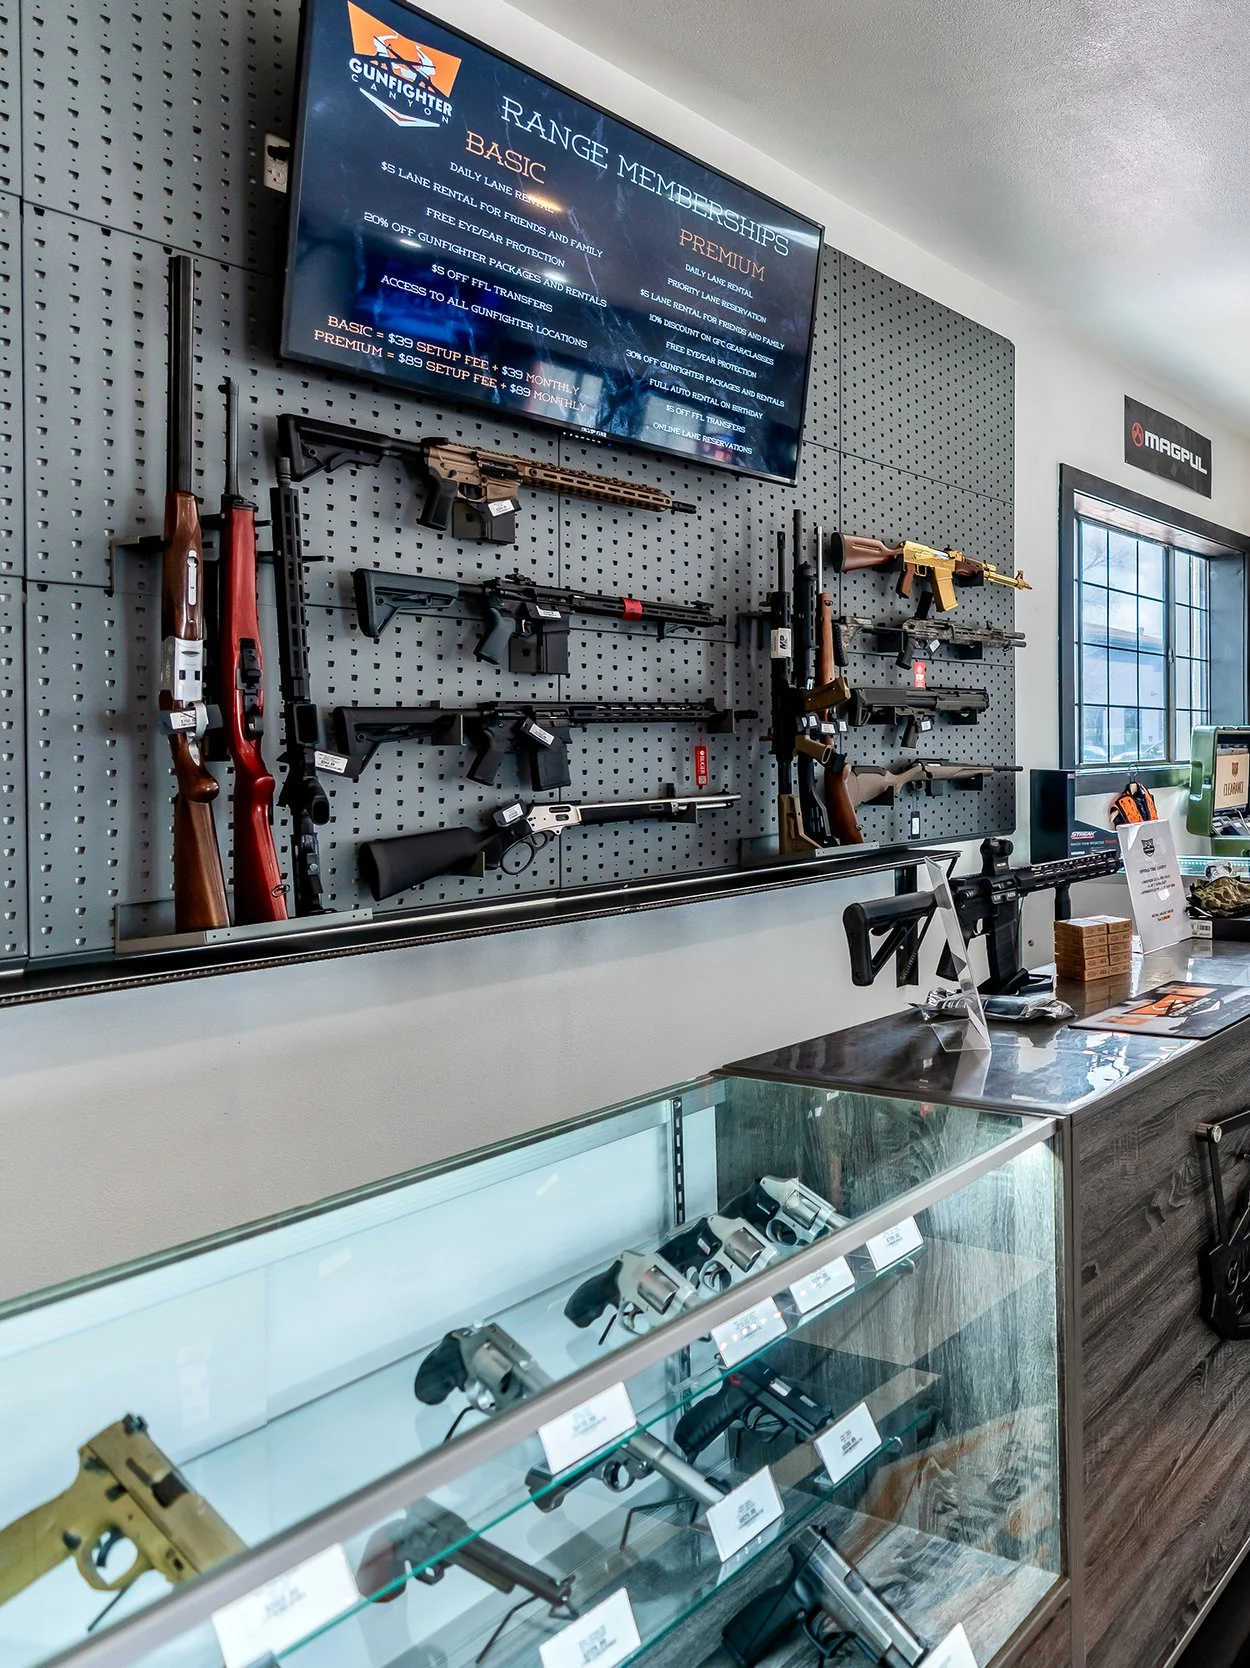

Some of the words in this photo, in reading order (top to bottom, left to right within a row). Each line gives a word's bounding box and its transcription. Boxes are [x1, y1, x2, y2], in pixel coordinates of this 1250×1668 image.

[349, 58, 453, 118] GUNFIGHTER
[351, 74, 449, 125] CANYON
[465, 130, 546, 184] BASIC
[501, 95, 609, 169] RANGE
[617, 154, 790, 257] MEMBERSHIPS
[398, 167, 431, 189] LANE
[433, 182, 478, 208] RENTAL
[479, 201, 502, 218] FOR
[503, 211, 546, 236] FRIENDS
[548, 230, 570, 245] AND
[570, 239, 604, 258] FAMILY
[450, 162, 482, 182] DAILY
[484, 176, 513, 196] LANE
[515, 190, 554, 213] RENTAL
[364, 211, 389, 228] 20%
[391, 221, 416, 238] OFF
[418, 232, 487, 264] GUNFIGHTER
[489, 256, 542, 284] PACKAGES
[543, 277, 564, 292] AND
[565, 286, 608, 308] RENTALS
[426, 207, 456, 226] FREE
[458, 219, 504, 245] EYE/EAR
[505, 232, 565, 268] PROTECTION
[679, 228, 766, 282] PREMIUM
[446, 269, 470, 285] OFF
[471, 278, 492, 293] FFL
[494, 285, 553, 313] TRANSFERS
[667, 277, 700, 297] PRIORITY
[701, 291, 721, 305] LANE
[721, 299, 767, 324] RESERVATION
[685, 263, 707, 278] DAILY
[707, 273, 727, 288] LANE
[727, 281, 754, 299] RENTAL
[380, 275, 427, 297] ACCESS
[428, 289, 445, 302] TO
[446, 296, 469, 310] ALL
[471, 303, 534, 333] GUNFIGHTER
[535, 324, 588, 349] LOCATIONS
[651, 292, 672, 308] LANE
[673, 301, 702, 319] RENTAL
[703, 313, 718, 325] FOR
[718, 319, 747, 336] FRIENDS
[747, 330, 761, 342] AND
[762, 336, 786, 350] FAMILY
[327, 315, 373, 339] BASIC
[388, 333, 414, 349] $39
[416, 341, 462, 363] SETUP
[464, 354, 489, 370] FEE
[501, 365, 524, 380] $39
[525, 372, 580, 396] MONTHLY
[649, 313, 663, 325] 10%
[663, 319, 700, 338] DISCOUNT
[700, 332, 712, 342] ON
[712, 337, 725, 348] GFC
[725, 341, 775, 366] GEAR/CLASSES
[666, 341, 686, 354] FREE
[686, 347, 716, 364] EYE/EAR
[717, 357, 757, 379] PROTECTION
[314, 329, 383, 359] PREMIUM
[398, 352, 423, 369] $89
[425, 360, 471, 381] SETUP
[473, 373, 498, 389] FEE
[509, 383, 531, 397] $89
[533, 390, 587, 413] MONTHLY
[626, 349, 642, 361] 30%
[643, 355, 659, 367] OFF
[660, 360, 705, 381] GUNFIGHTER
[705, 375, 741, 393] PACKAGES
[741, 388, 756, 399] AND
[756, 393, 785, 408] RENTALS
[649, 378, 669, 391] FULL
[670, 384, 691, 398] AUTO
[691, 391, 720, 407] RENTAL
[720, 399, 732, 410] ON
[732, 403, 764, 420] BIRTHDAY
[675, 407, 691, 418] OFF
[691, 411, 705, 422] FFL
[706, 415, 746, 434] TRANSFERS
[652, 421, 681, 436] ONLINE
[681, 428, 702, 441] LANE
[702, 434, 753, 455] RESERVATIONS
[1145, 430, 1208, 475] MAGPUL
